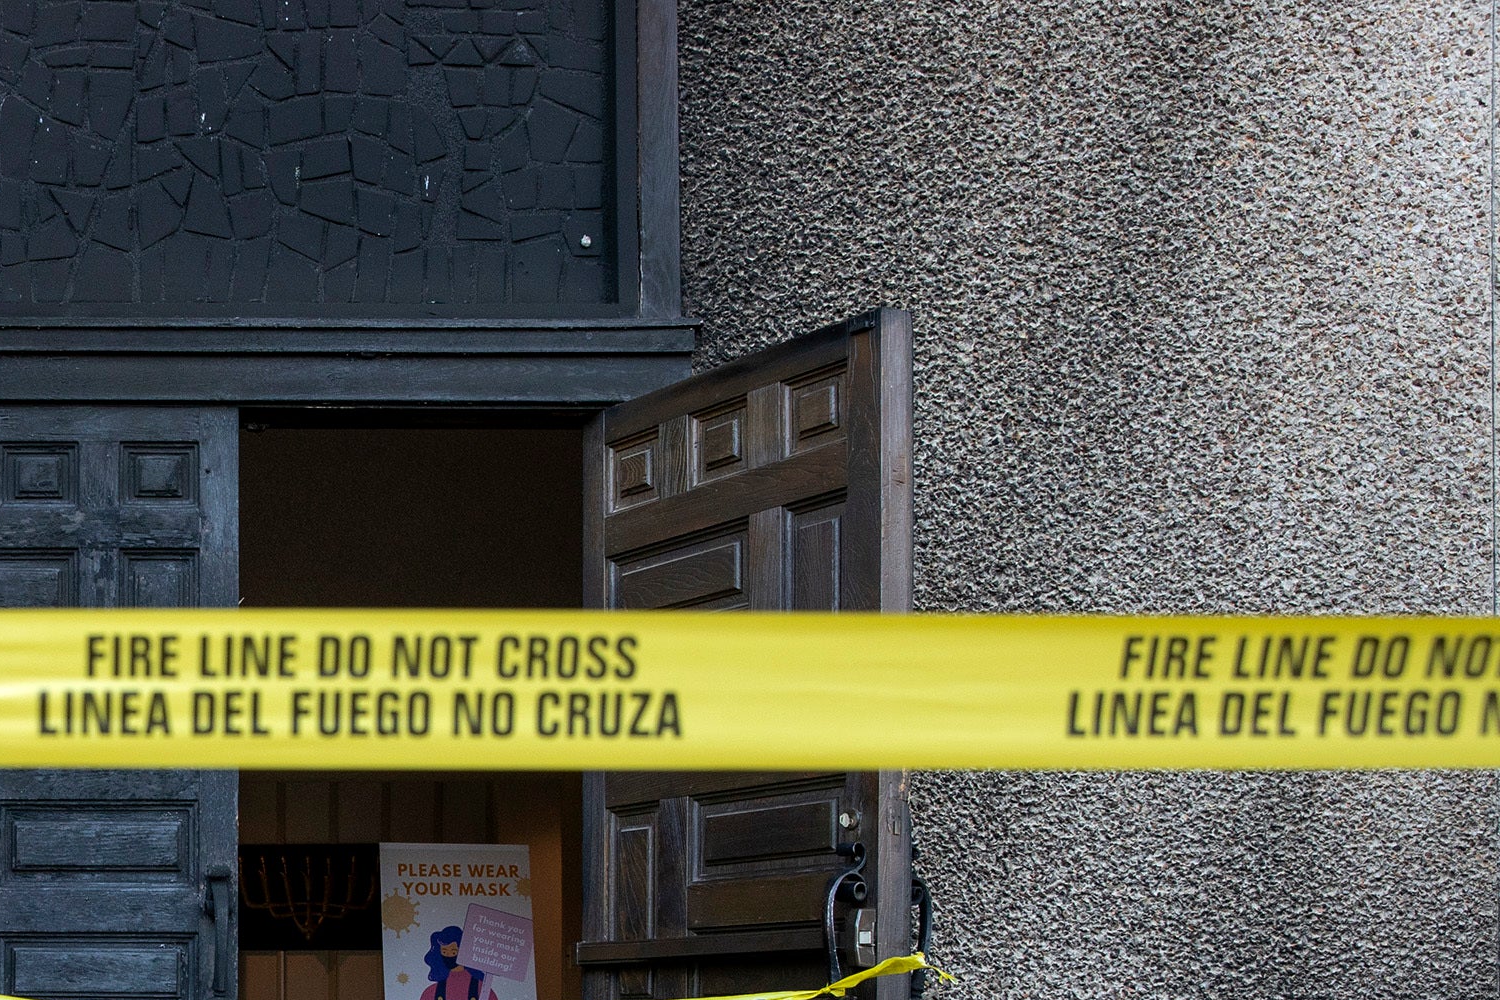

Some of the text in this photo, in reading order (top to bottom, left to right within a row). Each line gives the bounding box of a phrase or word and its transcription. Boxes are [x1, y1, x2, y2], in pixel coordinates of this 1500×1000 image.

[86, 634, 639, 679] FIRE LINE DO NOT CROSS
[1120, 635, 1500, 679] FIRE LINE DO NO
[38, 691, 682, 737] LINEA DEL FUEGO NO CRUZA
[1067, 689, 1197, 737] LINEA
[1219, 689, 1297, 737] DEL
[1318, 689, 1461, 737] FUEGO
[398, 863, 519, 878] PLEASE WEAR
[402, 882, 511, 896] YOUR MASK
[472, 923, 526, 946] for wearing
[479, 915, 525, 935] Thank you
[472, 944, 517, 962] inside our
[473, 936, 520, 953] your mask
[472, 953, 513, 972] building!
